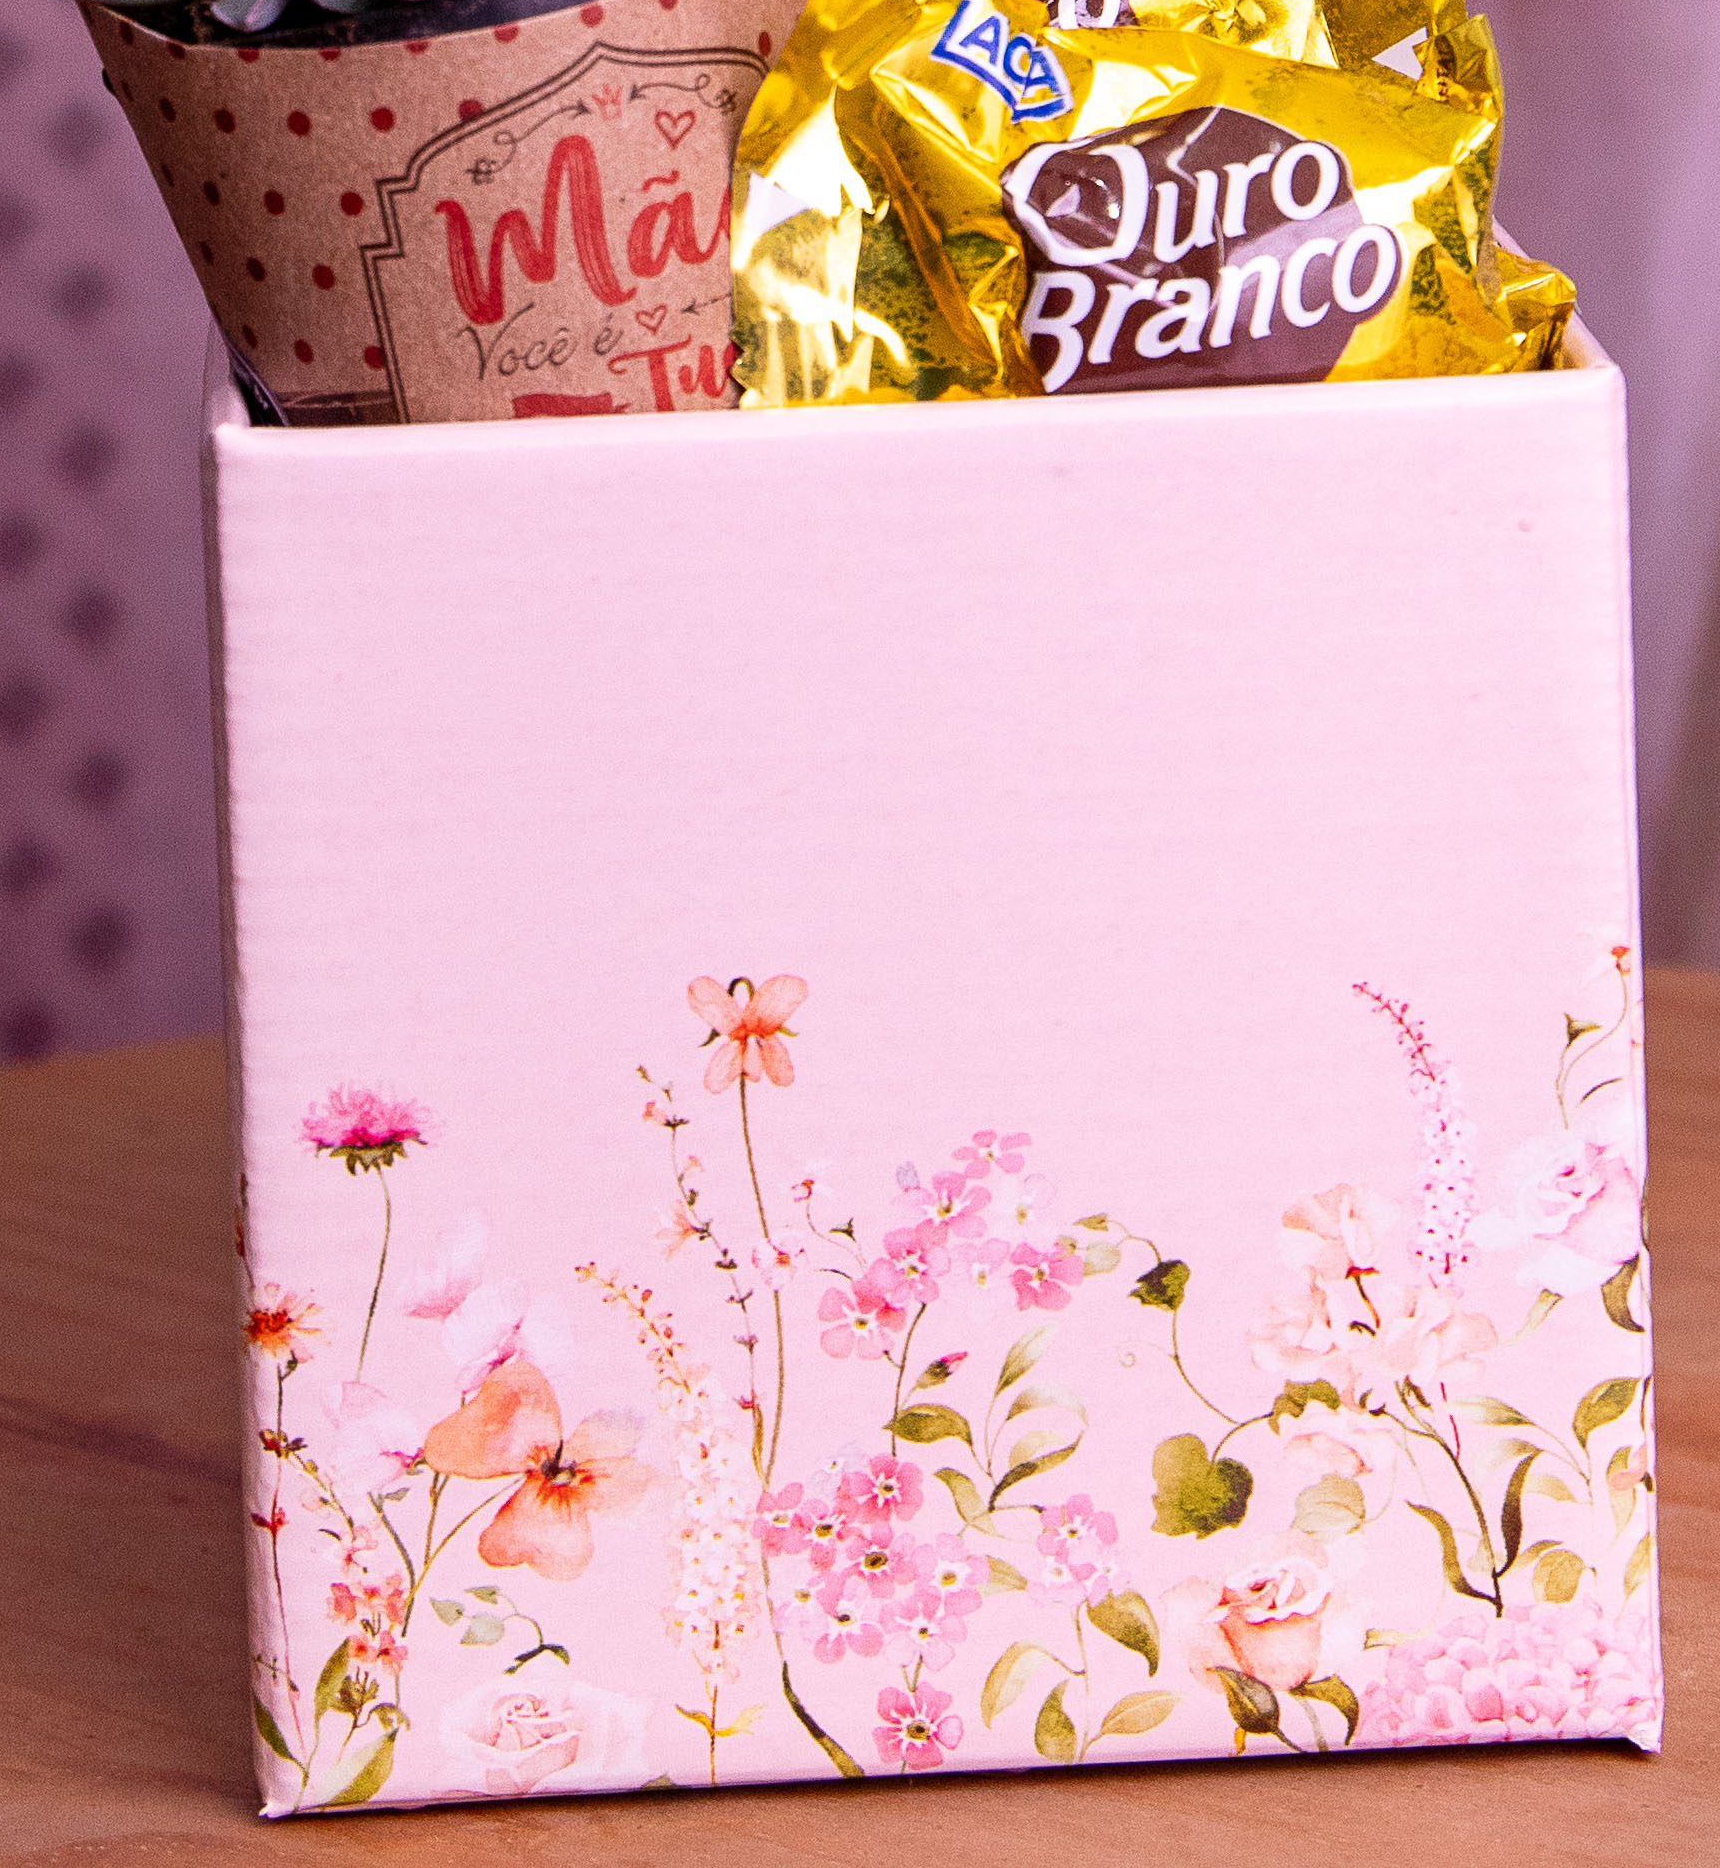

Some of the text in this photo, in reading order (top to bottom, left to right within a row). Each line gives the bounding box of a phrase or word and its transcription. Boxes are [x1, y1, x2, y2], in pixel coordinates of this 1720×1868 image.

[1005, 140, 1340, 266] Ouro
[456, 302, 578, 381] Você
[1020, 224, 1399, 393] Branco
